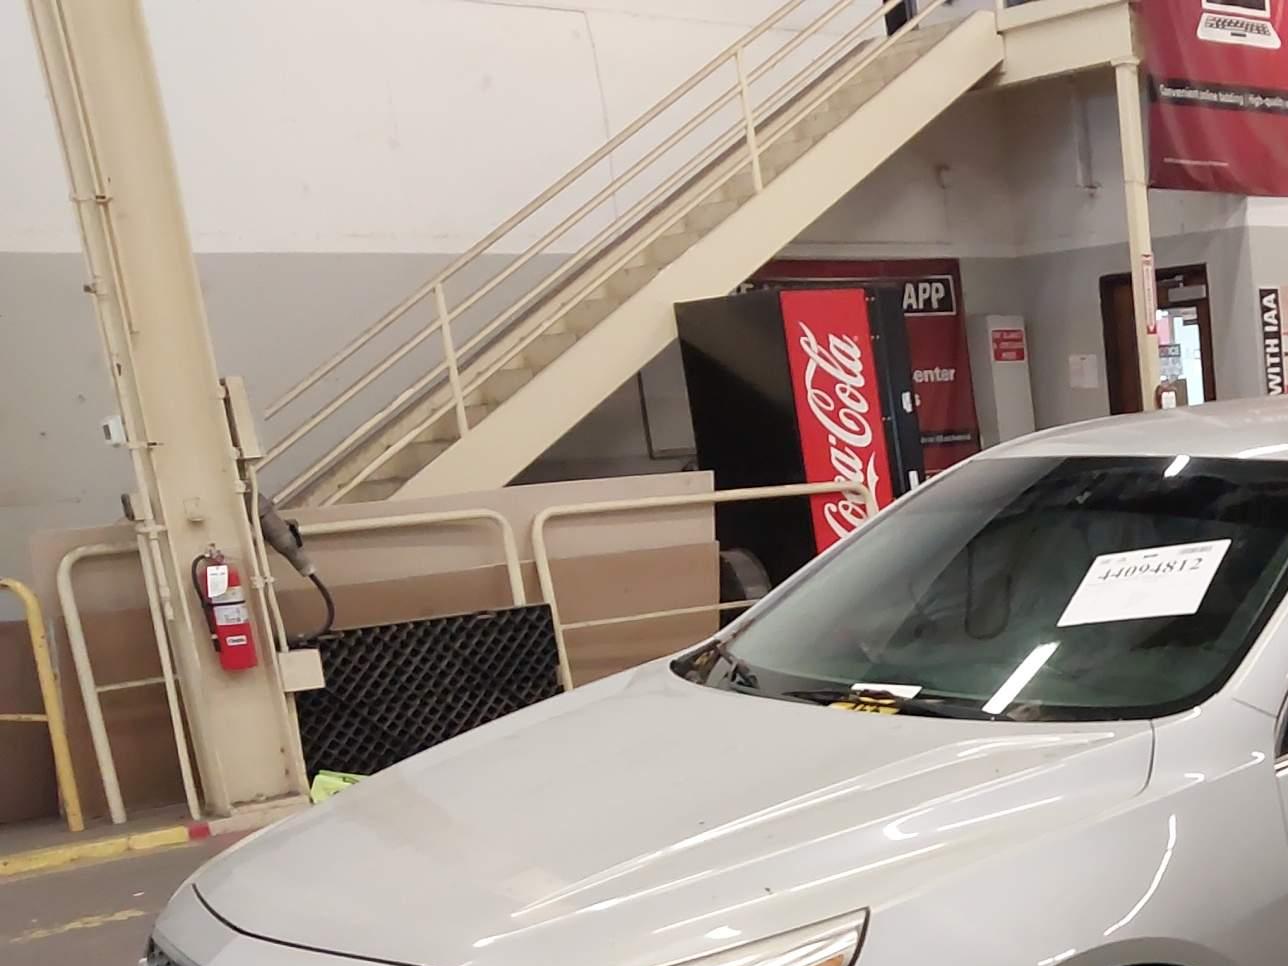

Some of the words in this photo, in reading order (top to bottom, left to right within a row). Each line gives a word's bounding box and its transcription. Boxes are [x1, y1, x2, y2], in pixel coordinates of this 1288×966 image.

[902, 283, 945, 310] APP
[1262, 293, 1279, 332] IAA
[1265, 338, 1282, 396] WITH
[1097, 557, 1204, 582] 44094812
